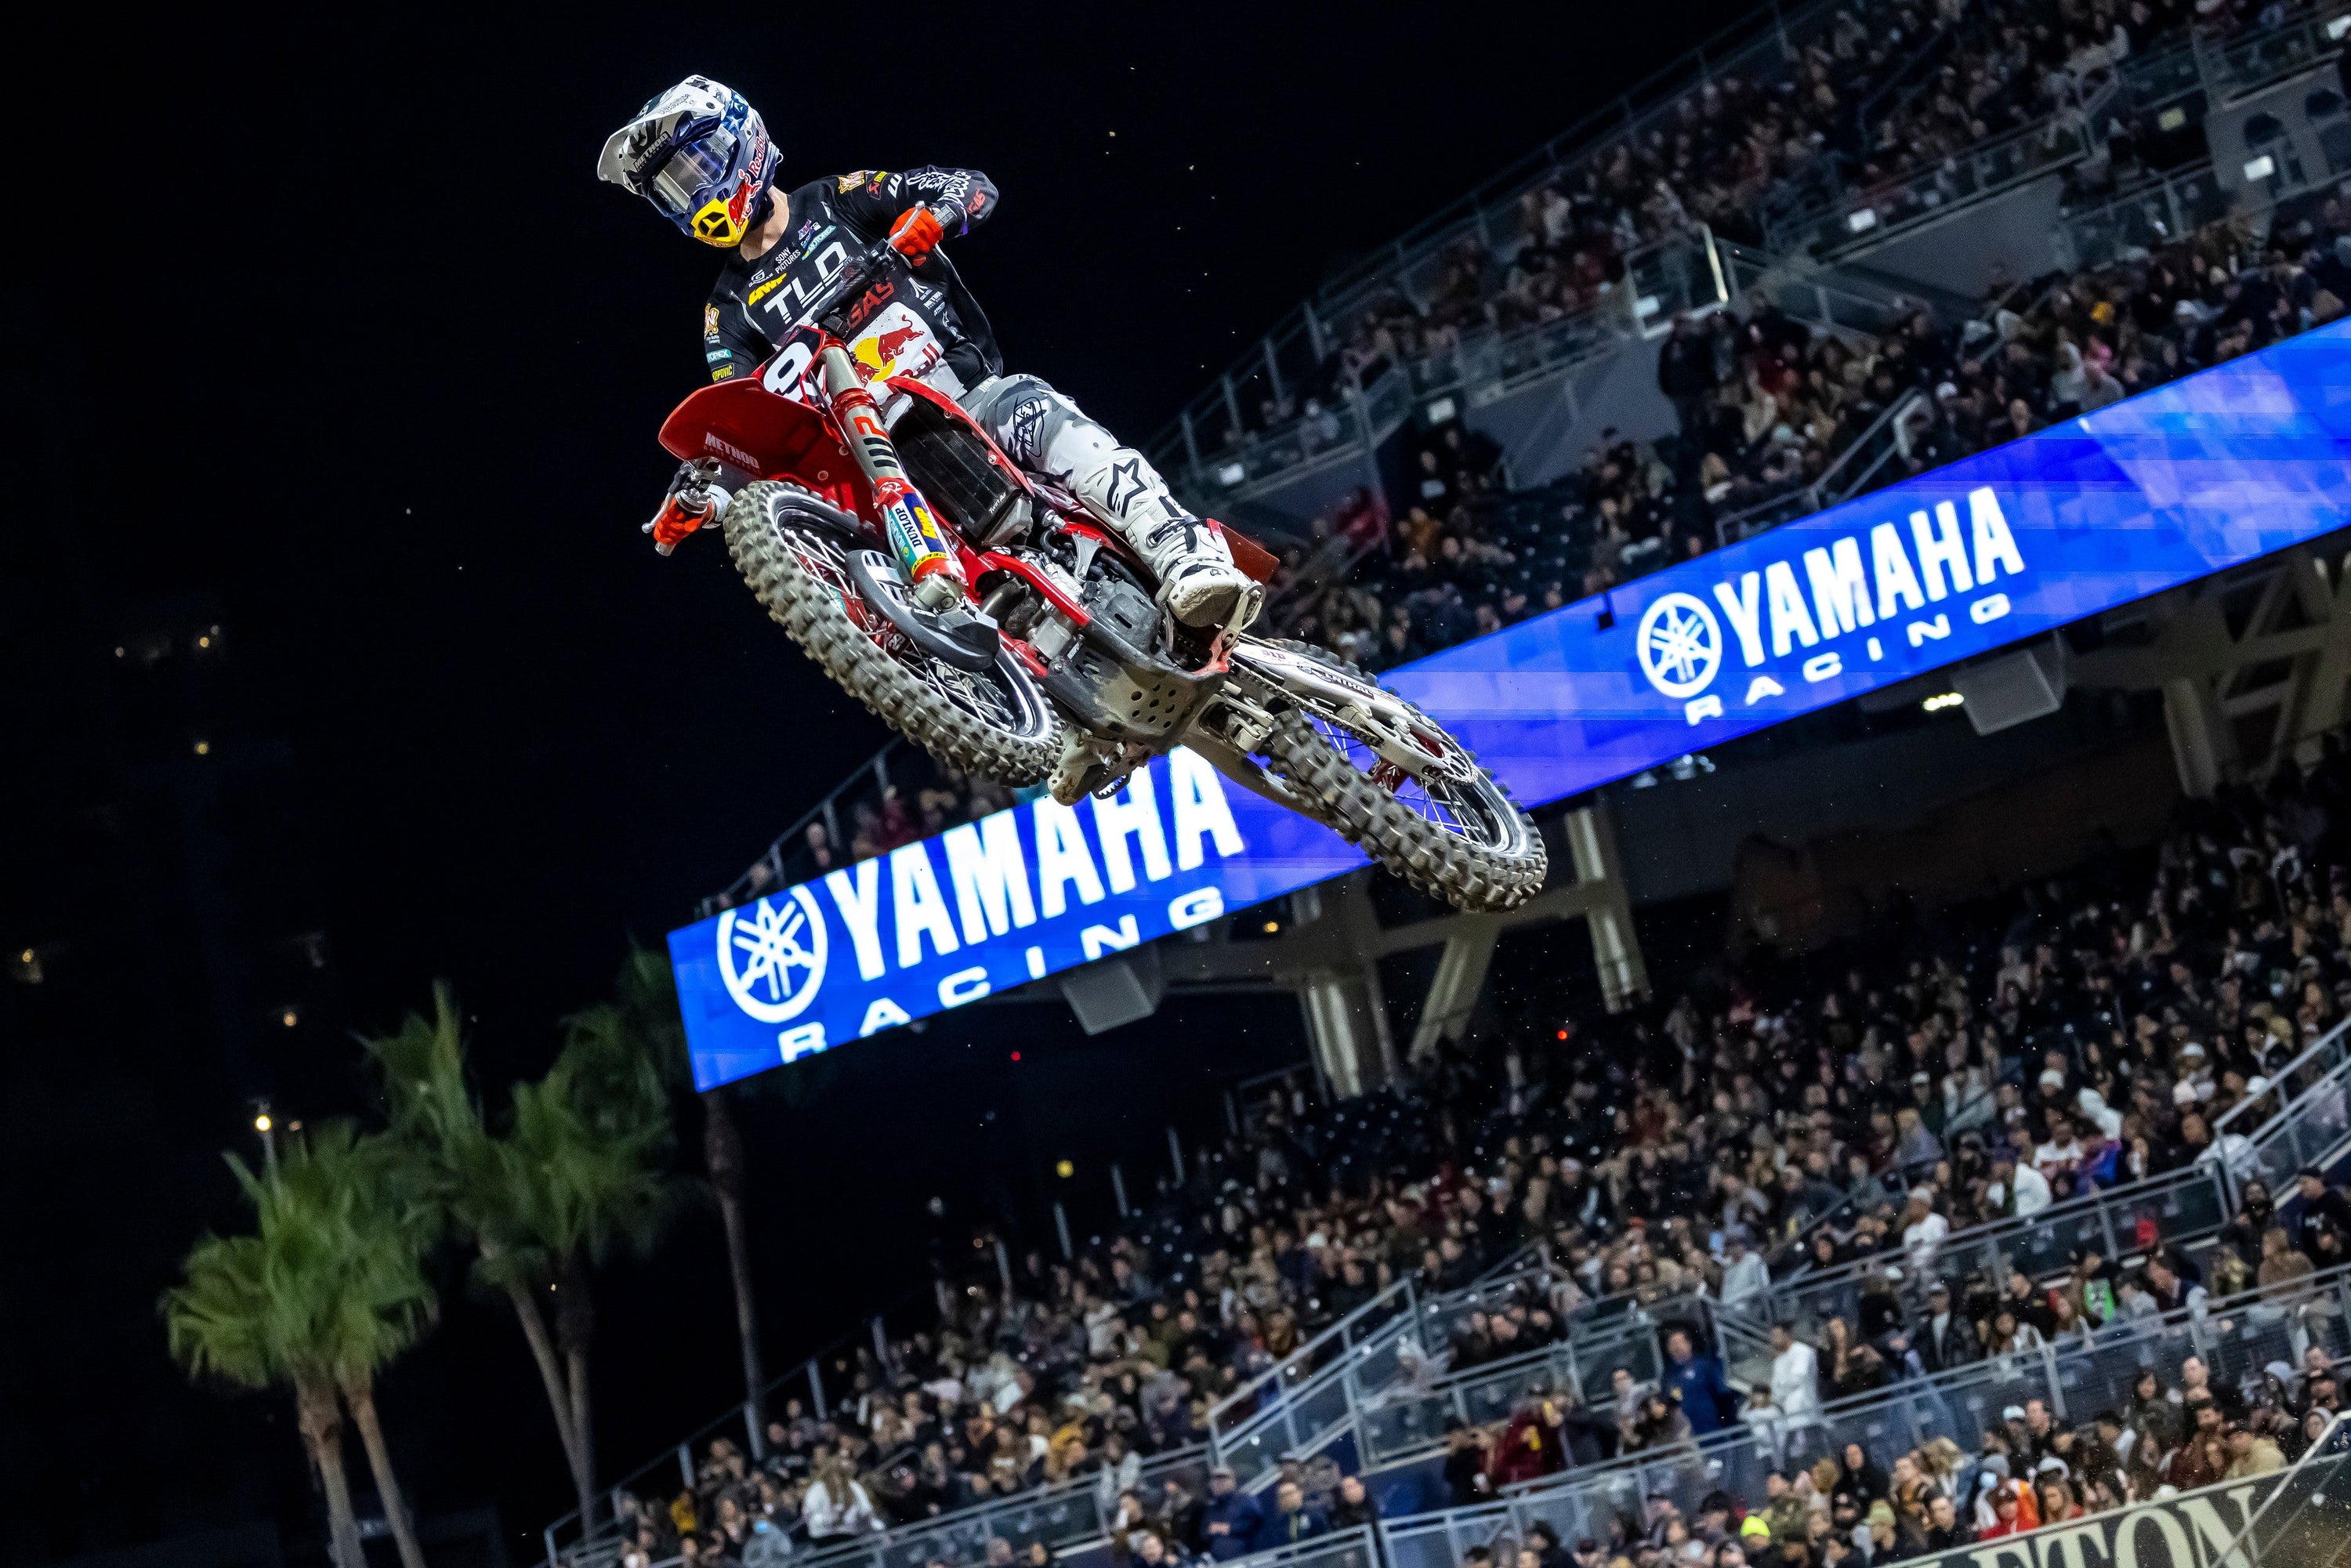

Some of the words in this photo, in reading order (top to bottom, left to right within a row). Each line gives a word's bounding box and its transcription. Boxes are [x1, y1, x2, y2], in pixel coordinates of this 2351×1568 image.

[775, 247, 792, 265] SONY
[775, 249, 802, 274] PICTURES
[808, 226, 834, 252] MOTOREX
[763, 241, 849, 325] TLD
[705, 432, 760, 470] METHOD
[896, 507, 923, 549] DUNLOP
[1713, 486, 2026, 668] YAMAHA
[1685, 593, 2012, 726] RACING
[824, 744, 1245, 983] YAMAHA
[777, 885, 1225, 1064] RACING
